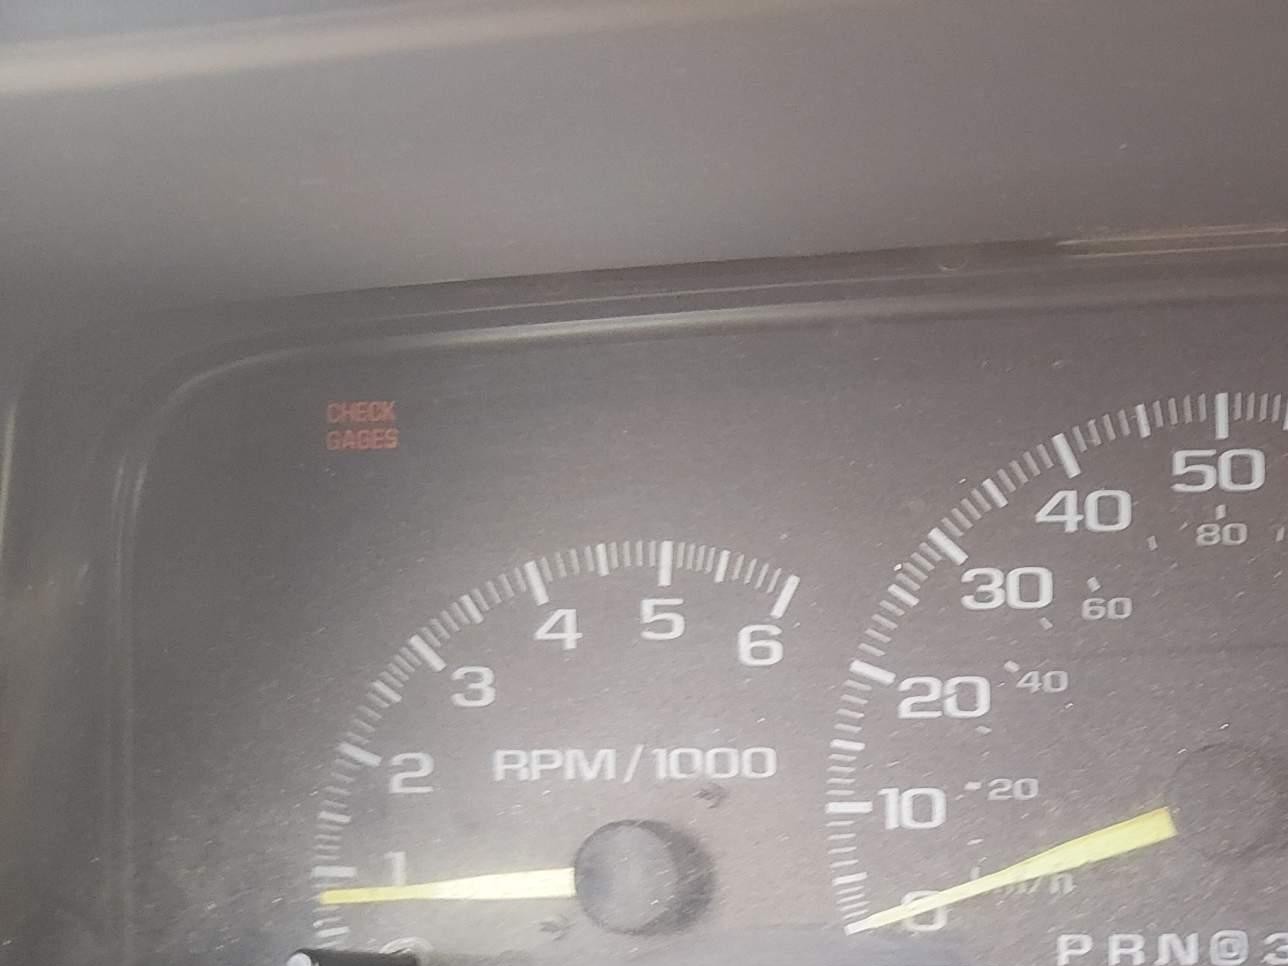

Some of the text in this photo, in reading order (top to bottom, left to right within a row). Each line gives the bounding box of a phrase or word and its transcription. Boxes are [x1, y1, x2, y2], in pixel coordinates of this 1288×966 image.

[327, 401, 396, 422] CHECK
[326, 429, 400, 450] GAGES
[1171, 448, 1266, 492] 50
[1036, 489, 1131, 531] 40
[1197, 524, 1247, 545] 80
[962, 567, 1054, 609] 30
[534, 608, 583, 650] 4
[640, 598, 684, 640] 5
[1082, 598, 1131, 620] 60
[738, 624, 784, 666] 6
[450, 666, 496, 707] 3
[898, 676, 990, 718] 20
[1018, 671, 1068, 693] 40
[388, 752, 435, 794] 2
[988, 779, 1038, 800] 20
[880, 787, 946, 829] 10
[384, 851, 407, 888] 1
[902, 890, 948, 931] 0
[1056, 933, 1093, 966] P
[1107, 933, 1146, 966] R
[1154, 933, 1199, 966] N
